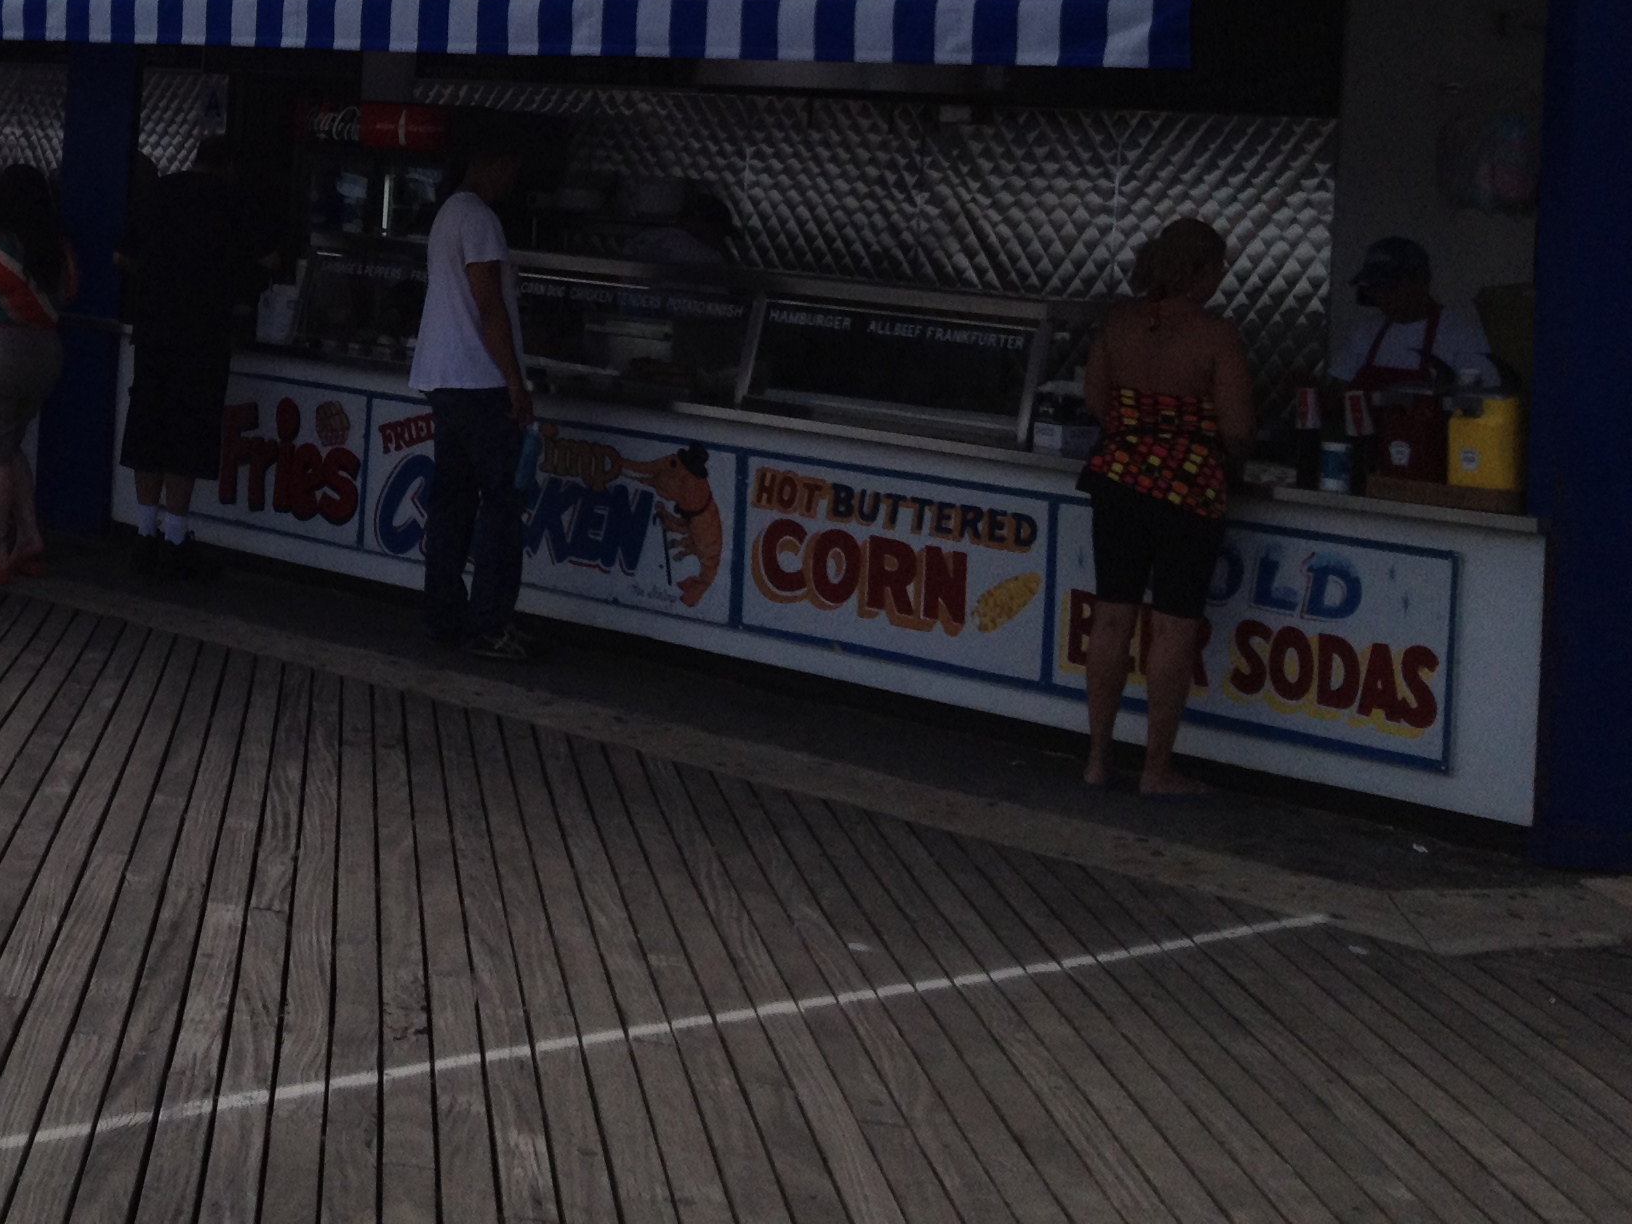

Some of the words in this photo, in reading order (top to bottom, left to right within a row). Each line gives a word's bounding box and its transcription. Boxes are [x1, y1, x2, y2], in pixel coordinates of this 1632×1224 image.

[768, 309, 853, 332] HAMBURGER
[925, 327, 1026, 351] FRANKFURTER
[218, 396, 362, 525] Fries
[751, 467, 825, 518] HOT
[827, 481, 1038, 553] BUTTERED
[751, 518, 967, 636] CORN
[1224, 619, 1441, 739] SODAS
